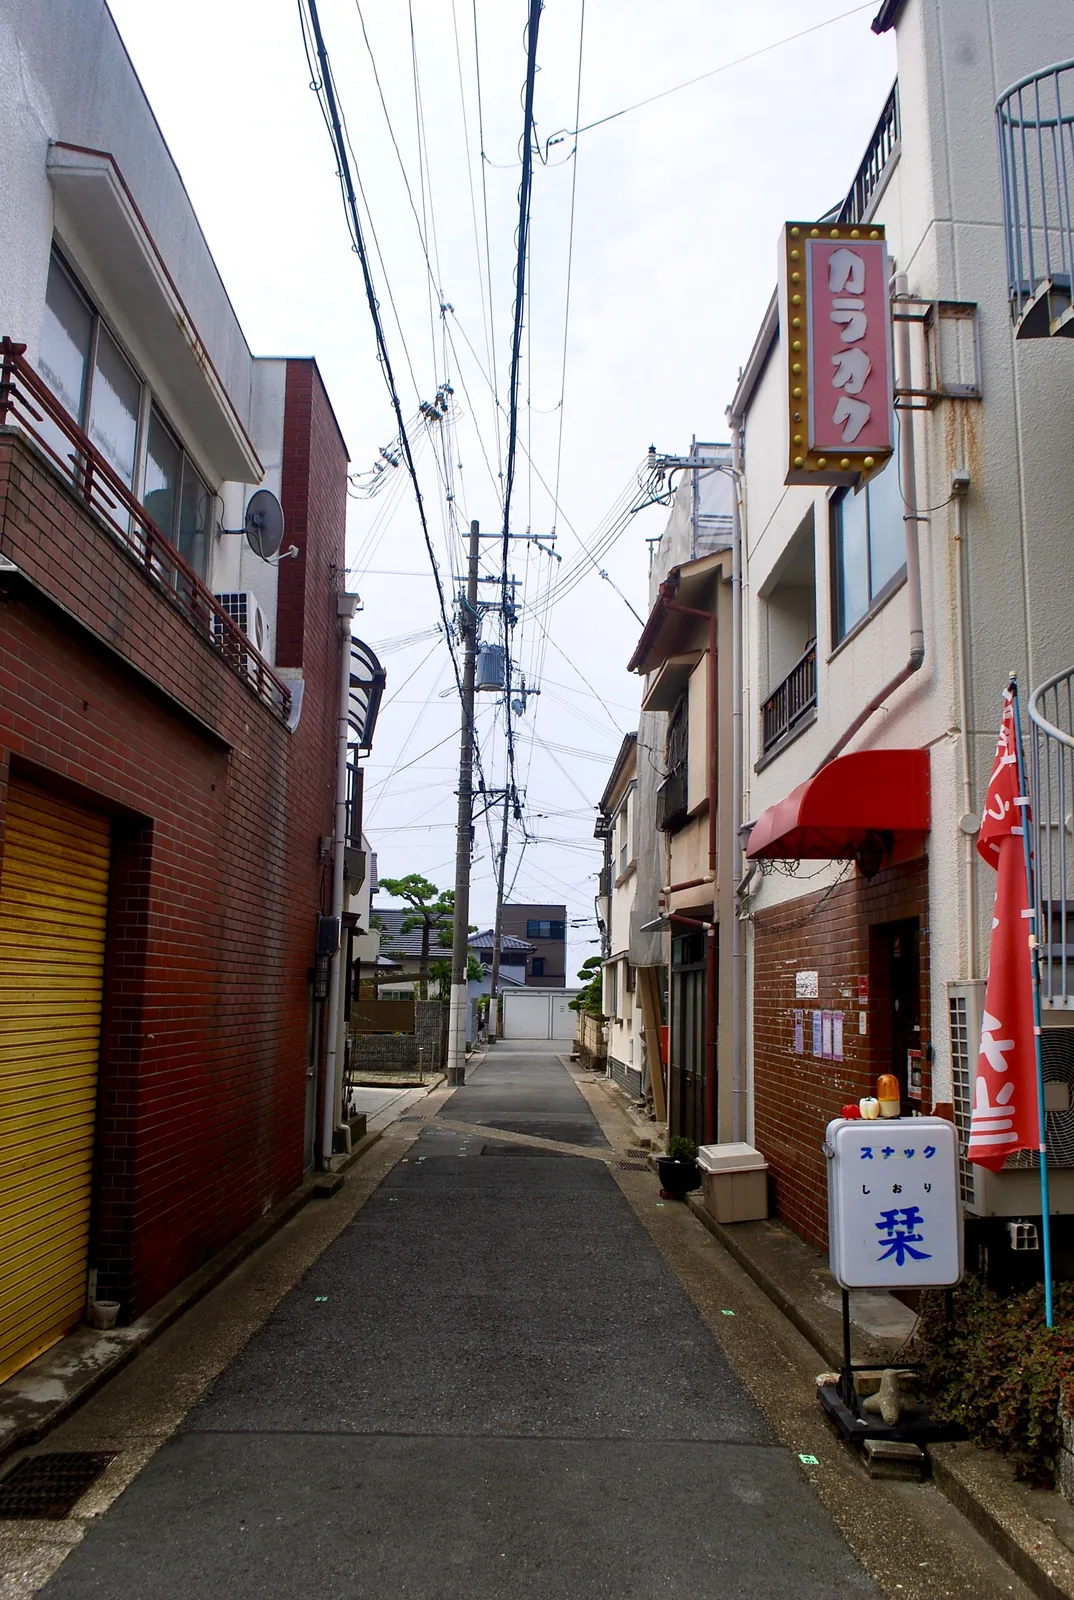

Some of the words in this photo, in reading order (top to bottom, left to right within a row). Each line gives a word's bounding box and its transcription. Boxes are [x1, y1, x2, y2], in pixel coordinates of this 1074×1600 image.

[860, 1145, 936, 1159] スナック
[862, 1183, 931, 1195] しおり
[875, 1206, 932, 1266] 栞
